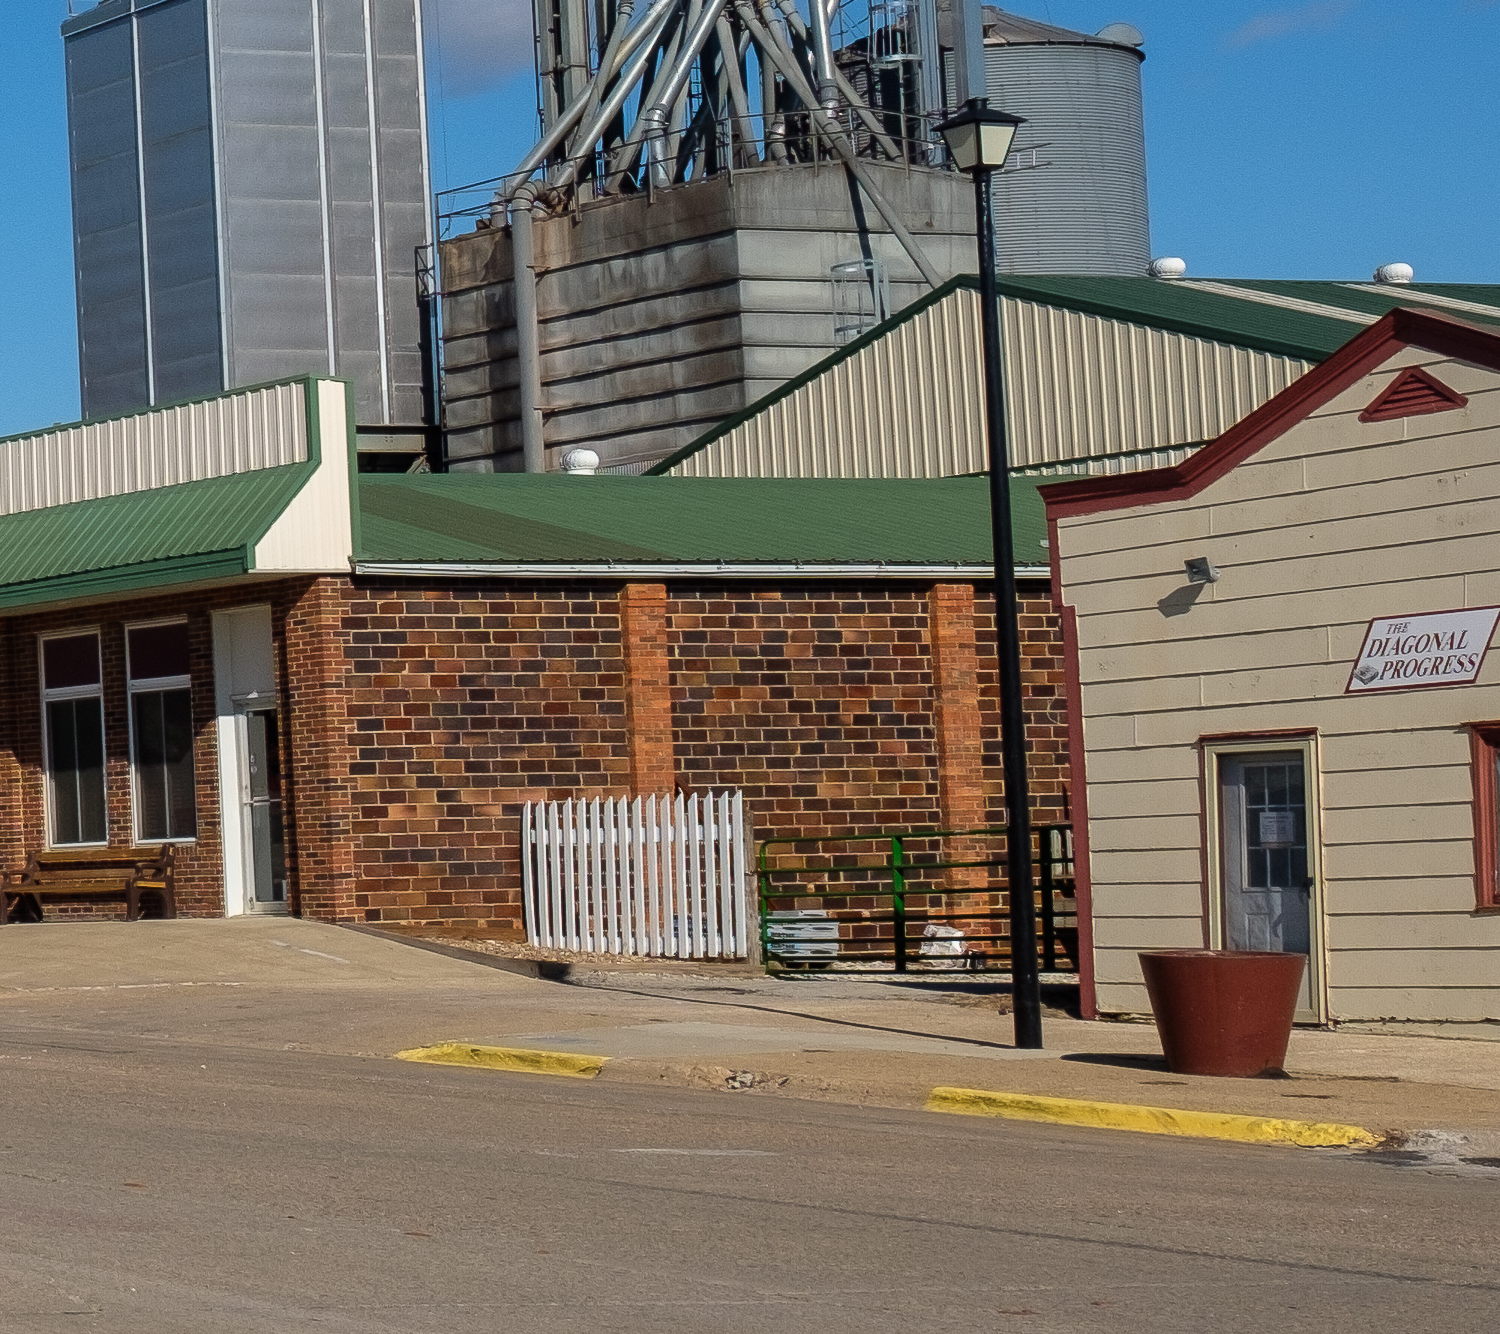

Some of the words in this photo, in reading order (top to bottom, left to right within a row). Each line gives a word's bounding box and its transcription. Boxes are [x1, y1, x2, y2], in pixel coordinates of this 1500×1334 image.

[1386, 621, 1411, 635] THE
[1365, 629, 1469, 659] DIAGONAL
[1377, 653, 1479, 681] PROGRESS
